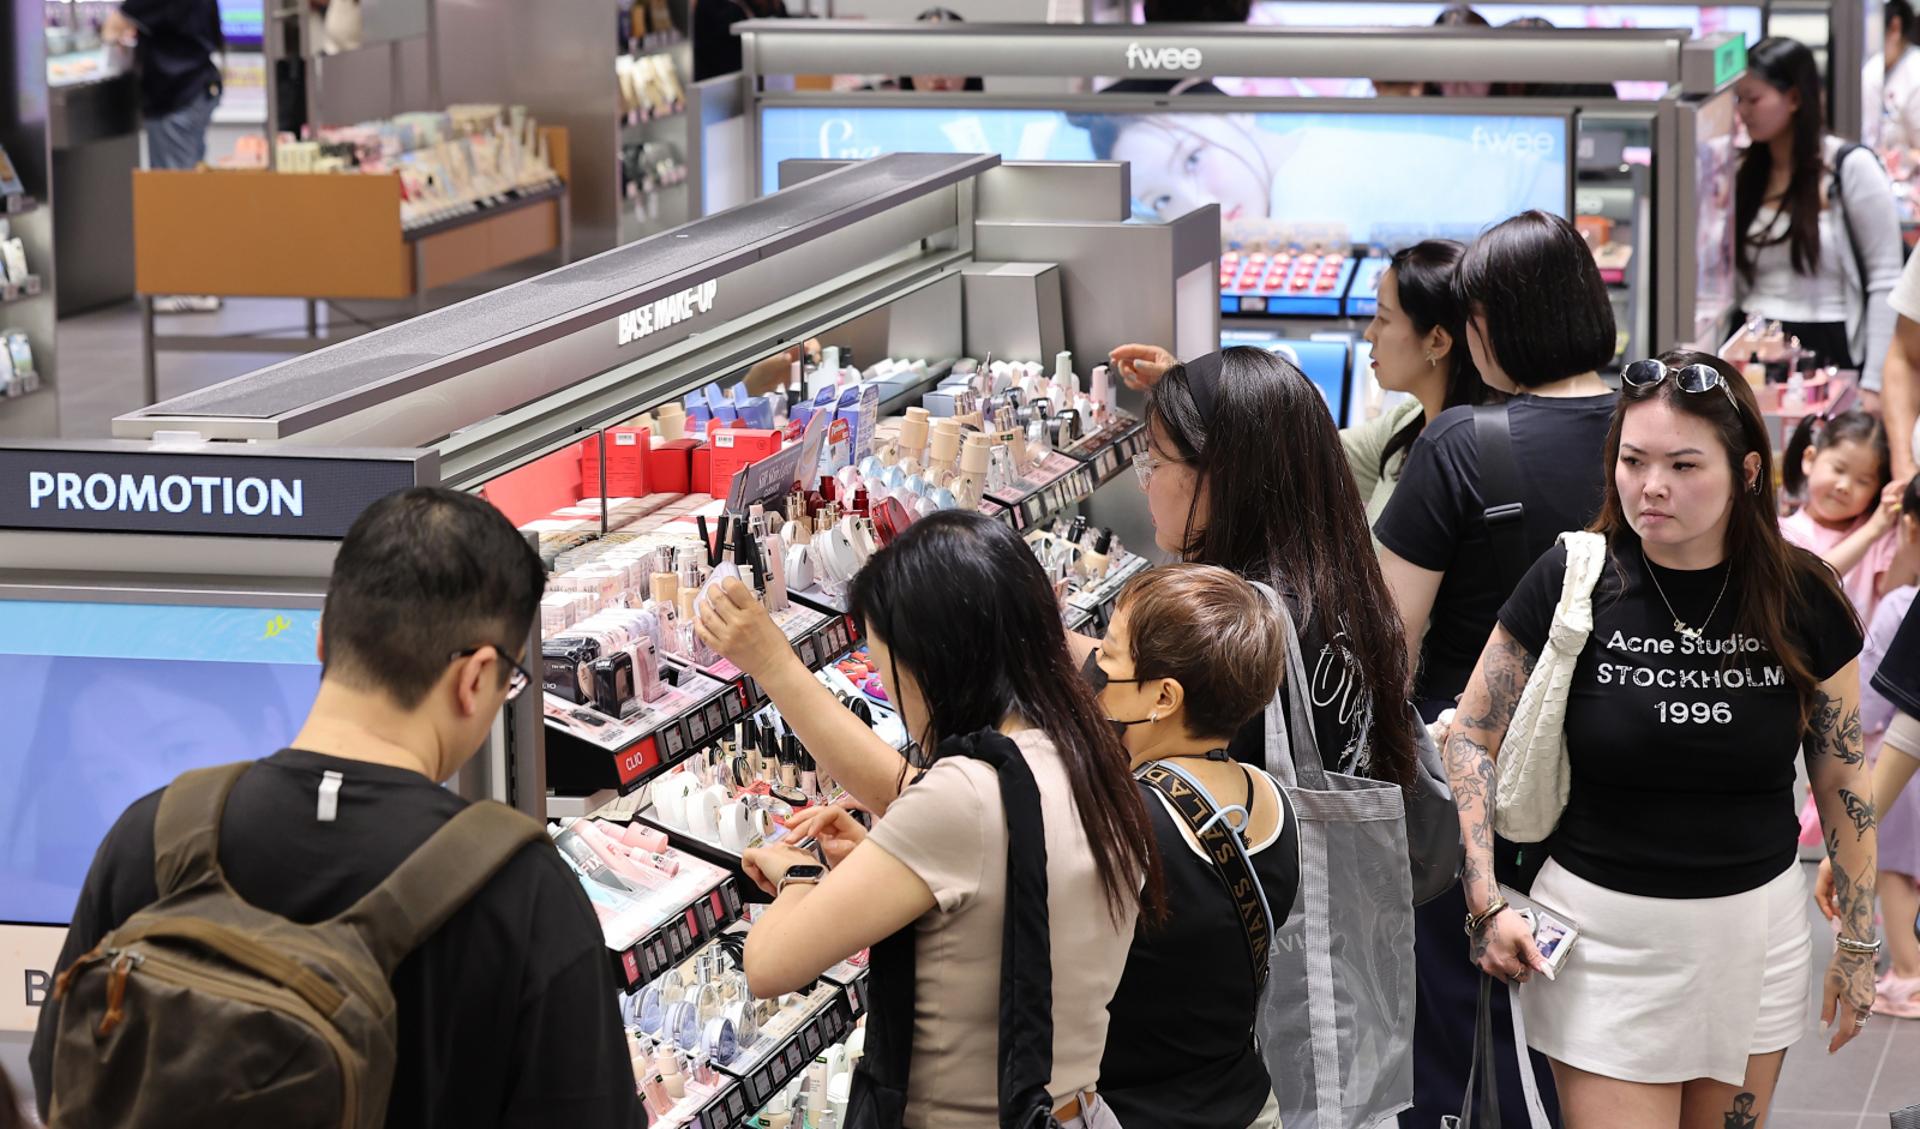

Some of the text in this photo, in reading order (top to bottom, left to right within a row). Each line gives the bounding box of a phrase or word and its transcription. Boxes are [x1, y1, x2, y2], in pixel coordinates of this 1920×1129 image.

[1125, 42, 1203, 70] fwee
[1471, 126, 1555, 154] fwee
[618, 279, 718, 346] BASE MAKE-UP
[29, 472, 304, 517] PROMOTION
[1606, 630, 1675, 654] Acne
[1597, 662, 1786, 689] STOCKHOLM
[1653, 701, 1733, 724] 1996
[625, 751, 643, 771] CLIO
